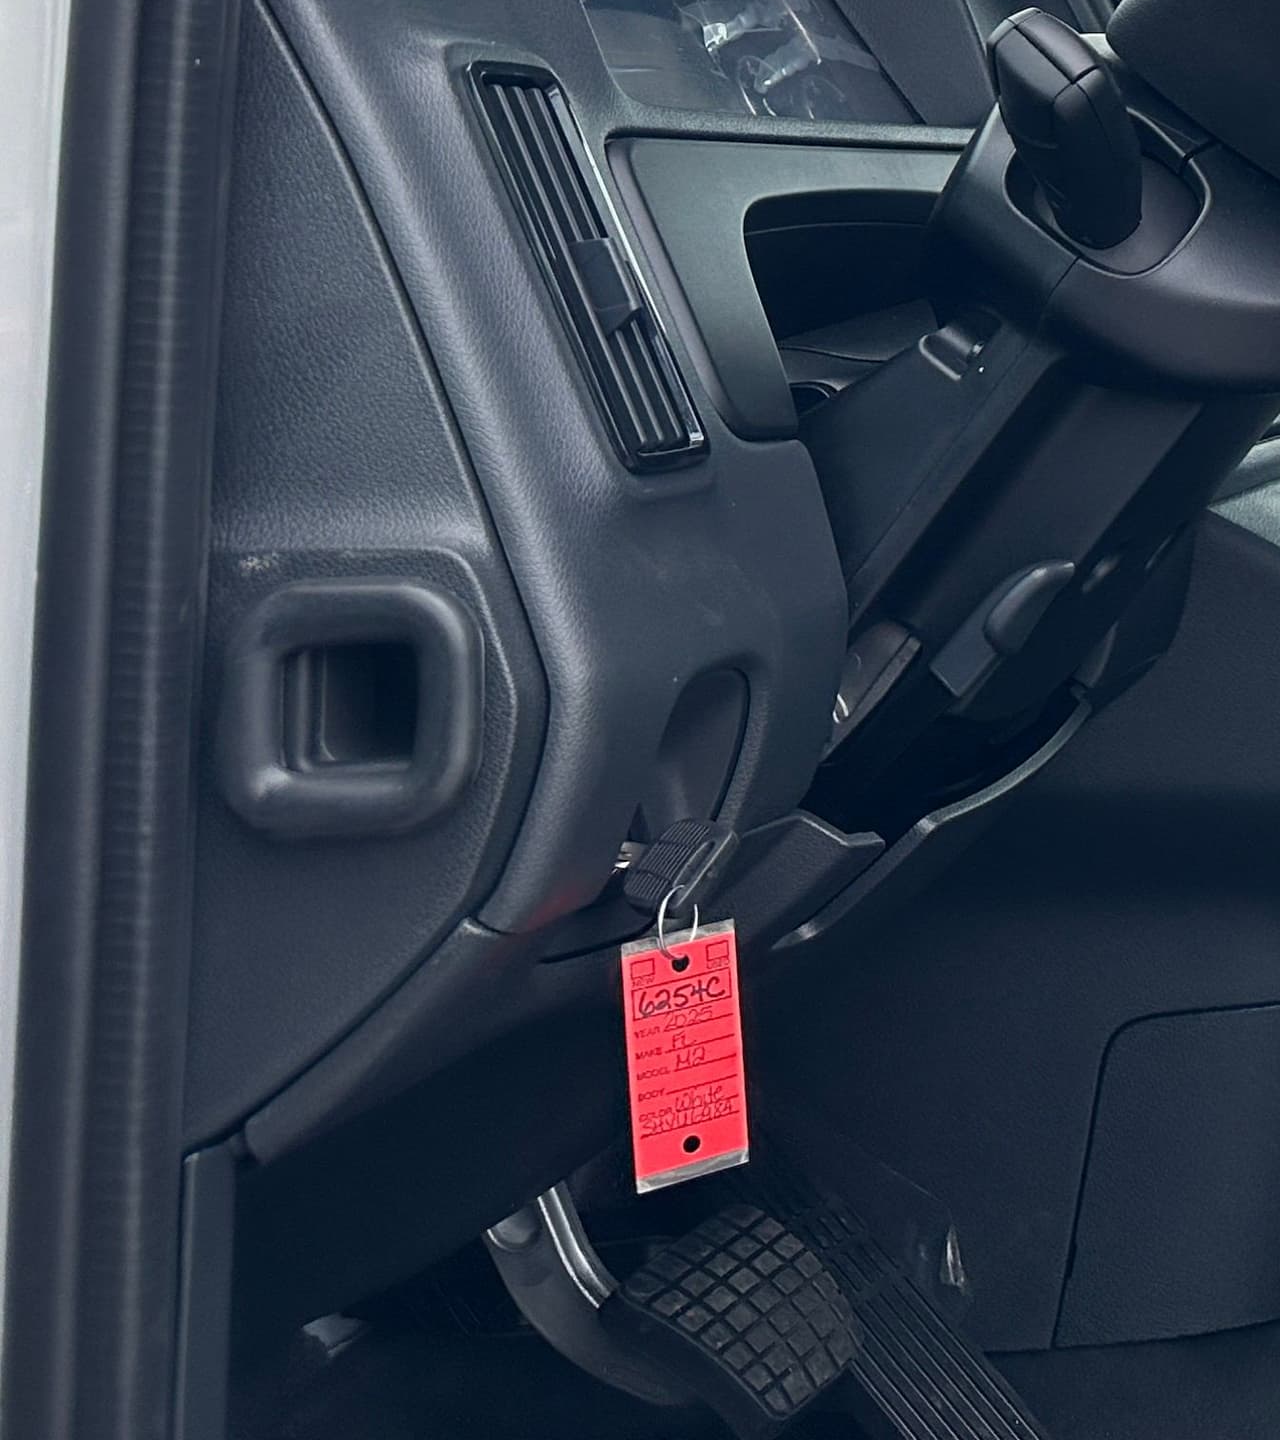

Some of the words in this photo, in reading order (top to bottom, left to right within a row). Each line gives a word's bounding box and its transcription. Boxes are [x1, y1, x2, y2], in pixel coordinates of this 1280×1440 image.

[638, 976, 725, 1017] 6254C
[663, 1007, 712, 1031] 2025
[634, 1026, 661, 1038] YEAR
[635, 1047, 663, 1060] MAKE
[636, 1067, 670, 1081] MODEL
[637, 1088, 665, 1102] BODY
[674, 1085, 724, 1112] White
[638, 1107, 673, 1122] COLOR
